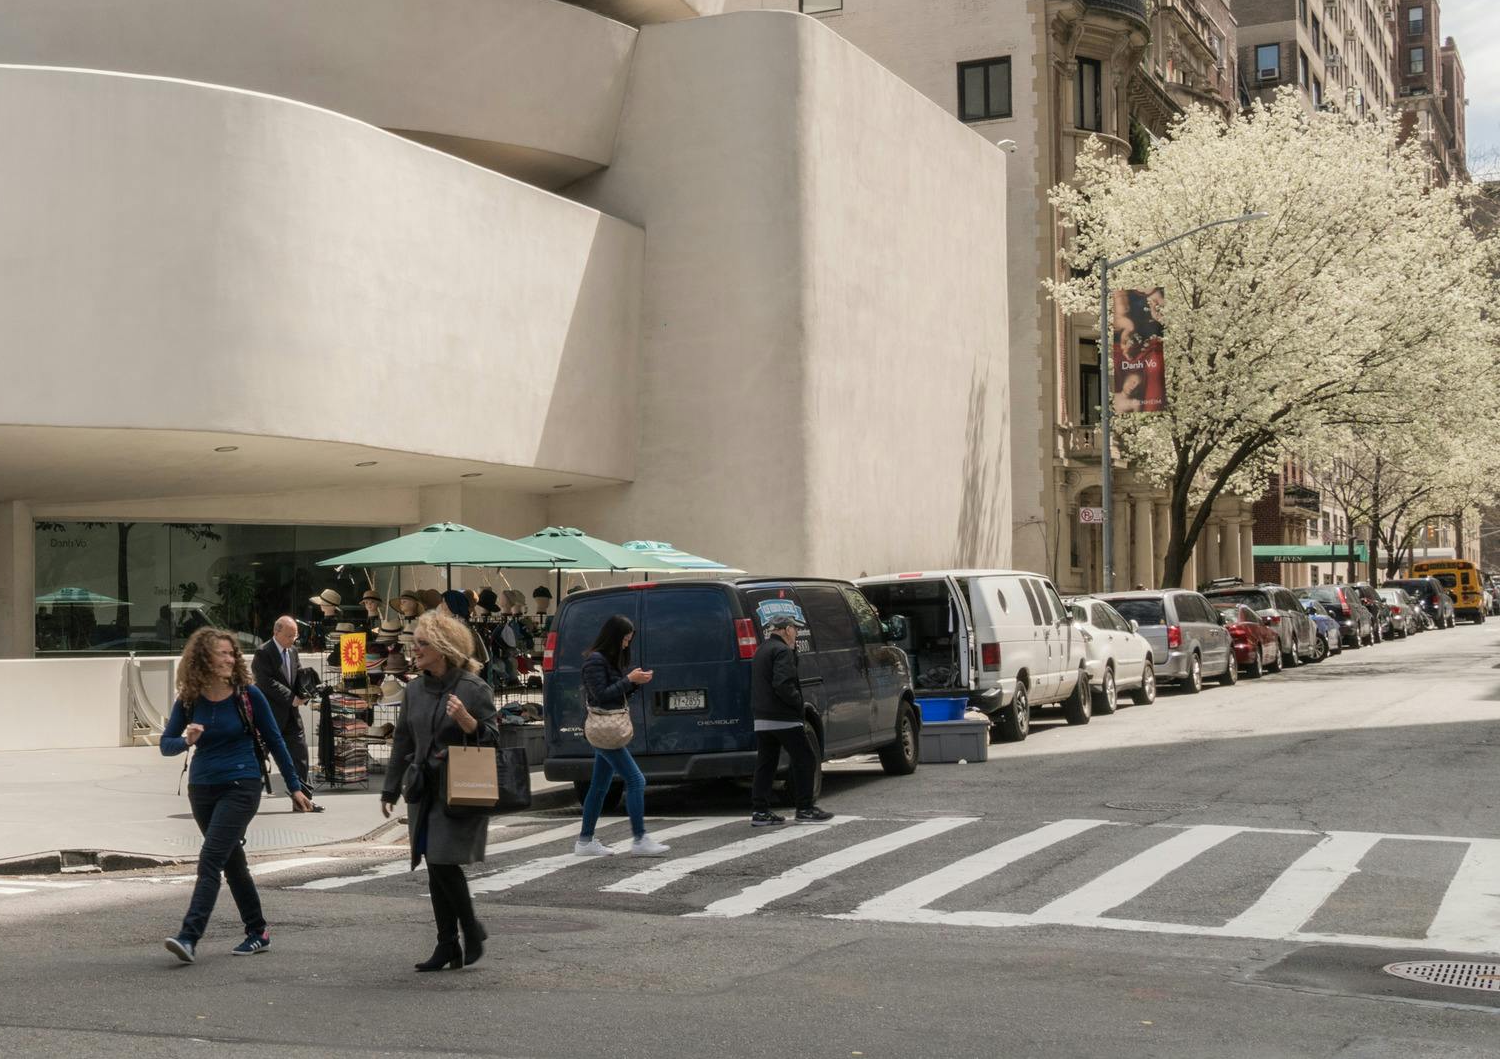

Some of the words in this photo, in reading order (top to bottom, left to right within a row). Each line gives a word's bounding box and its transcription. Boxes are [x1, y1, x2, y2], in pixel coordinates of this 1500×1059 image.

[1121, 360, 1144, 370] Danh
[1145, 359, 1157, 368] Vo
[697, 718, 741, 726] CHEVROLET
